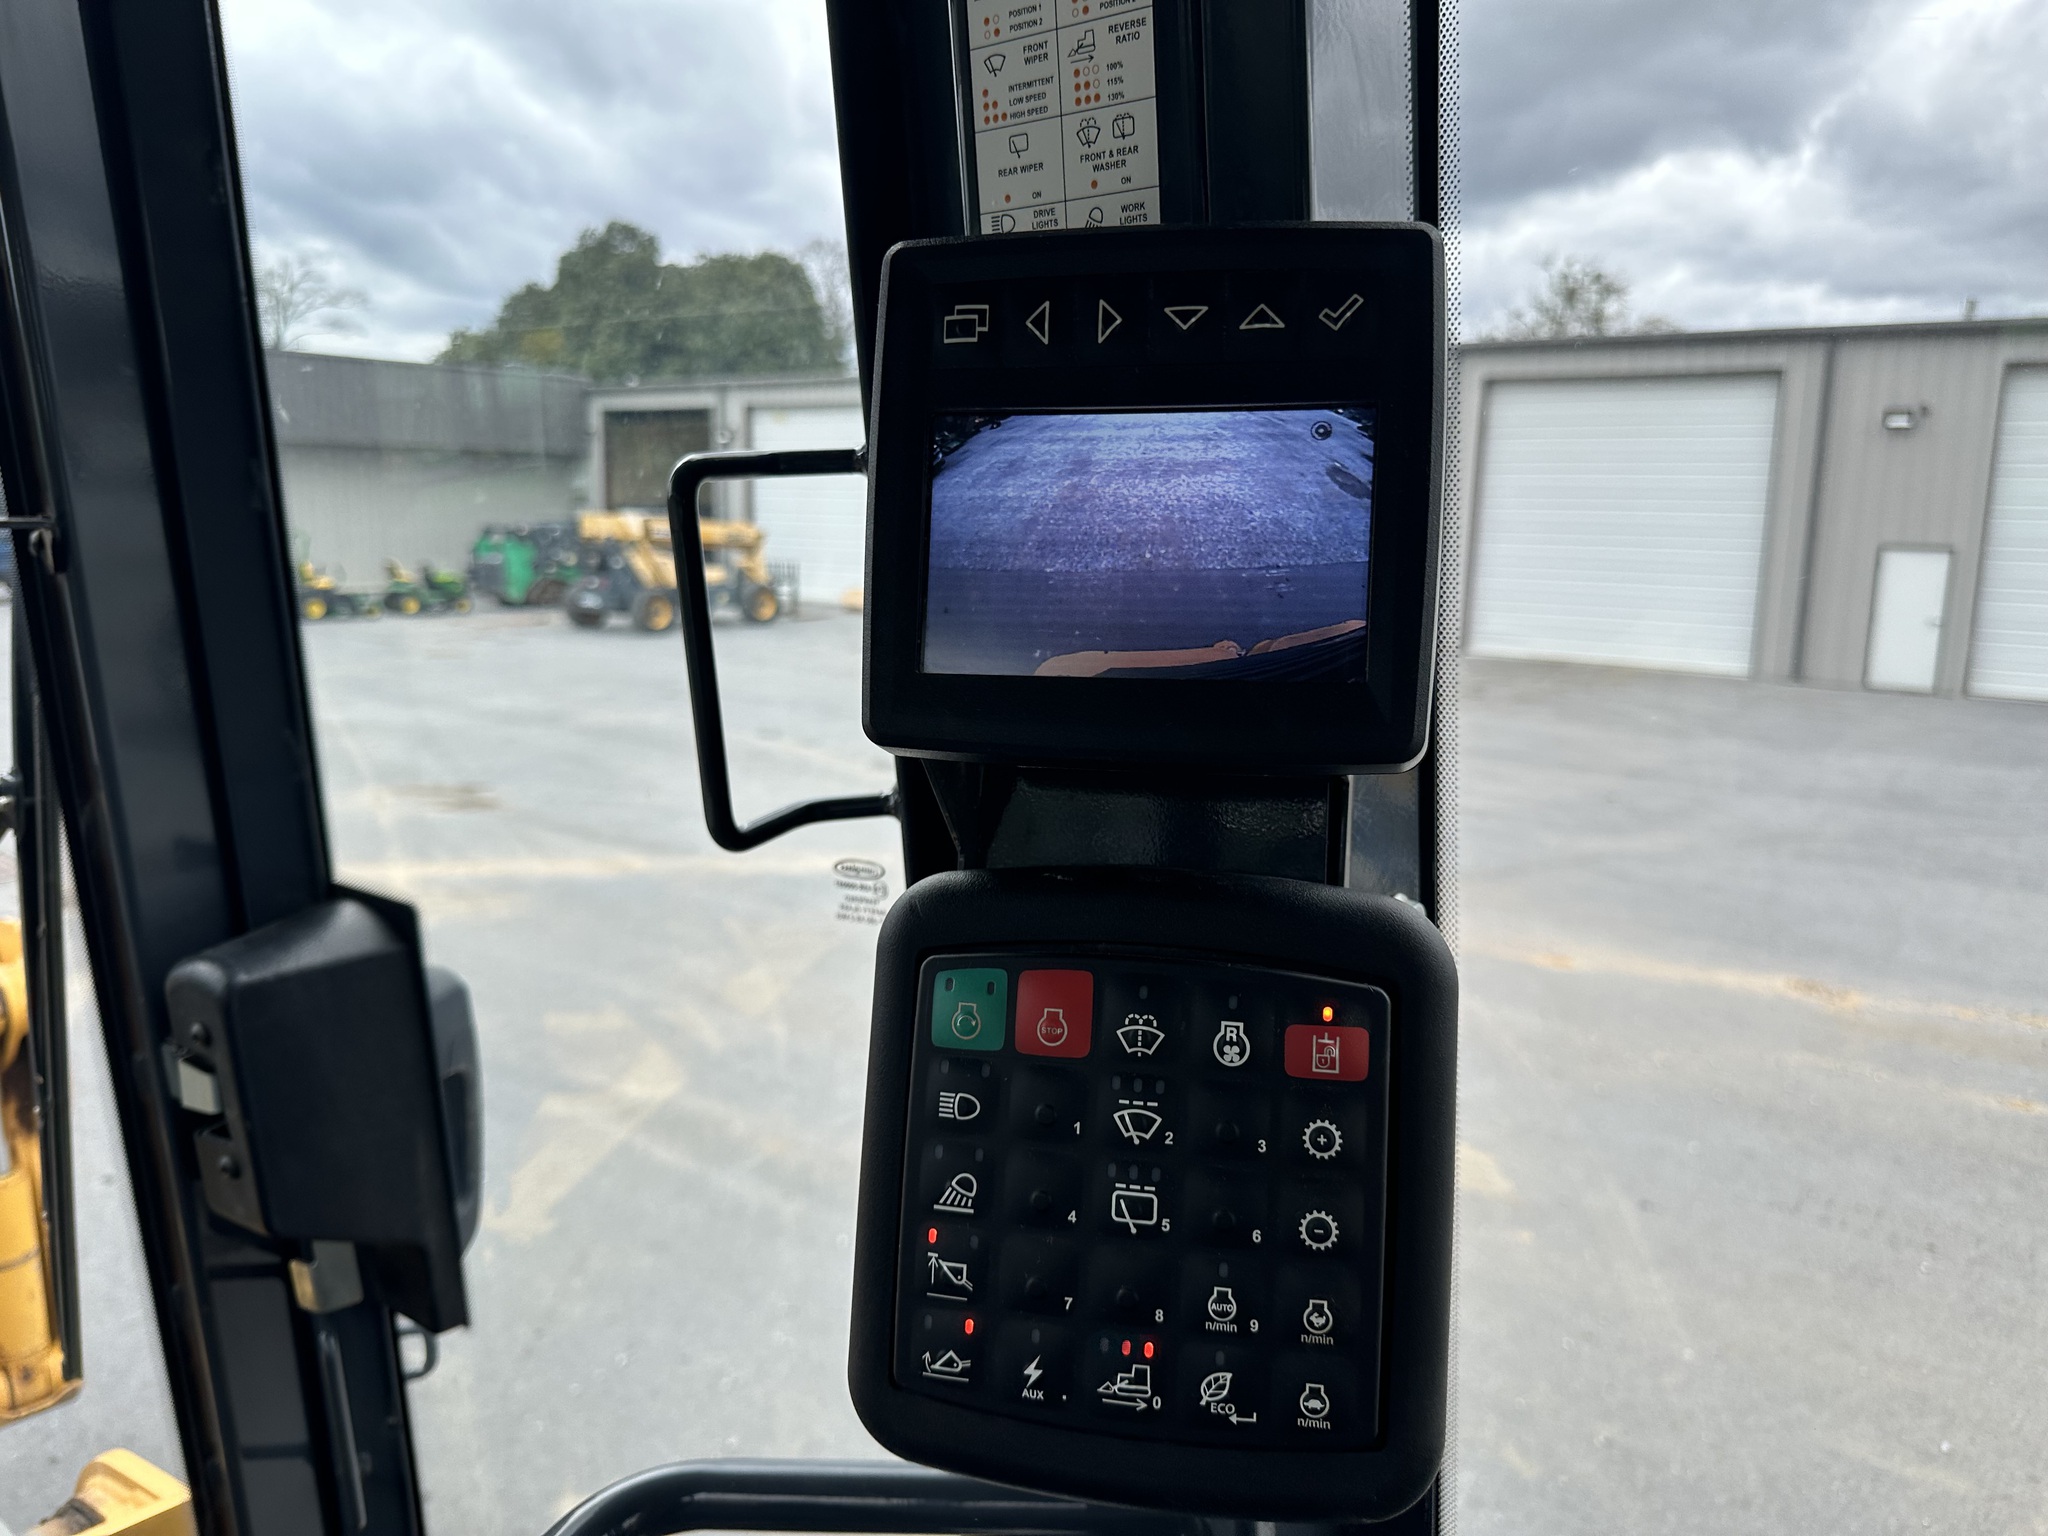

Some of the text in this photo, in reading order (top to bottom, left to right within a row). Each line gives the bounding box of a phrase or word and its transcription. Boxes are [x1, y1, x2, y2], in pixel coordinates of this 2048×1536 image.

[1009, 6, 1037, 19] POSITION
[1009, 21, 1038, 33] POSITION
[1108, 17, 1147, 34] REVERSE
[1115, 31, 1140, 45] RATIO
[1023, 41, 1048, 55] FRONT
[1024, 54, 1049, 66] WIPER
[1106, 61, 1123, 72] 100%
[1008, 76, 1054, 93] INTERMITTENT
[1107, 76, 1124, 87] 115%
[1009, 92, 1047, 107] LOW SPEED
[1107, 92, 1125, 102] 130%
[1009, 106, 1049, 120] HIGH SPEED
[1080, 145, 1139, 164] FRONT & REAR
[998, 162, 1044, 178] REAR WIPER
[1092, 159, 1127, 173] WASHER
[1121, 176, 1132, 185] ON
[1032, 191, 1042, 199] ON
[1033, 208, 1056, 219] DRIVE
[1120, 202, 1146, 214] WORK
[1031, 219, 1059, 231] LIGHTS
[1119, 214, 1148, 226] LIGHTS
[1041, 1026, 1063, 1035] STOP
[1226, 1026, 1237, 1042] R
[1073, 1121, 1081, 1135] 1
[1164, 1131, 1174, 1145] 2
[1257, 1139, 1267, 1153] 3
[1067, 1209, 1077, 1224] 4
[1161, 1218, 1171, 1232] 5
[1252, 1229, 1262, 1243] 6
[1064, 1296, 1074, 1311] 7
[1211, 1302, 1234, 1313] AUTO
[1155, 1308, 1164, 1322] 8
[1205, 1320, 1238, 1334] n/min
[1250, 1319, 1259, 1333] 9
[1300, 1333, 1334, 1346] n/min
[1021, 1388, 1044, 1400] AUX
[1152, 1396, 1161, 1410] 0
[1210, 1403, 1236, 1415] ECO
[1297, 1416, 1331, 1430] n/min
